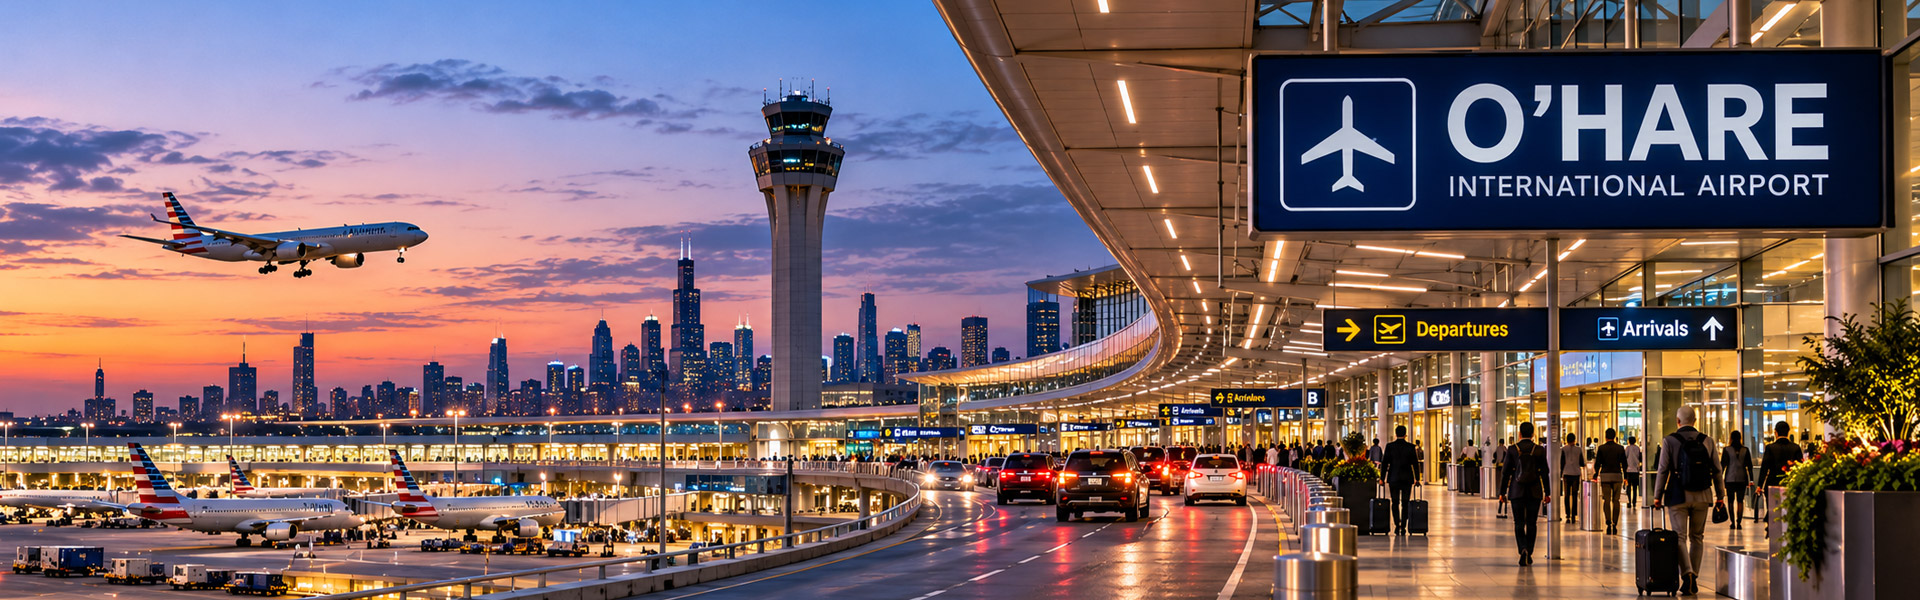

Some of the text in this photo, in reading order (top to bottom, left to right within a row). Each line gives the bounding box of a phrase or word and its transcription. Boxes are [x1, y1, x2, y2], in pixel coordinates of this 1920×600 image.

[1449, 173, 1829, 197] INTERNATIONAL AIRPORT
[1416, 320, 1509, 341] Departures
[1623, 319, 1689, 338] Arrivals
[1307, 392, 1319, 405] B
